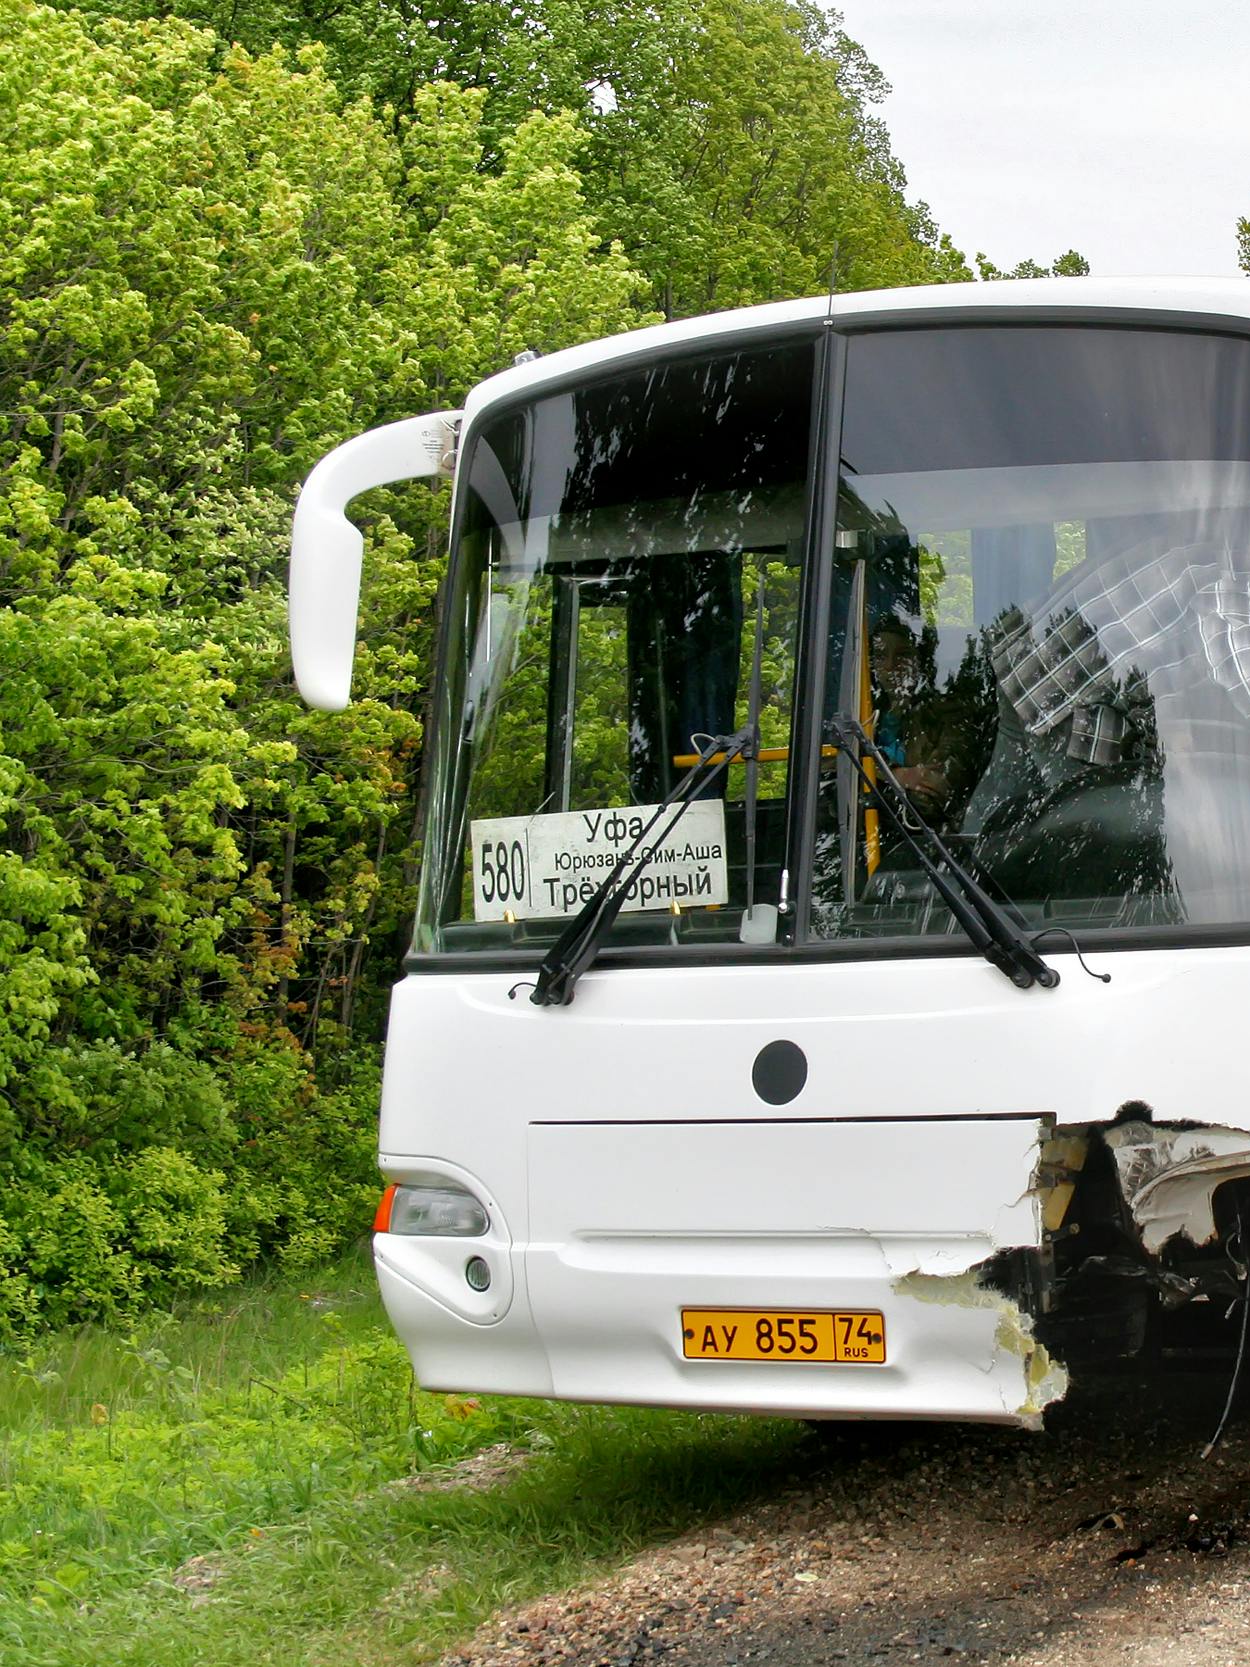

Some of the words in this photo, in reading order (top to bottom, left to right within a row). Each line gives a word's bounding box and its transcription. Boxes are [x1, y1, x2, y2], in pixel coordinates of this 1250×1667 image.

[583, 812, 644, 848] Уфа
[481, 840, 525, 903] 580
[543, 866, 712, 912] Трёгорный
[701, 1325, 738, 1353] АУ
[756, 1318, 818, 1354] 855
[838, 1317, 872, 1345] 74
[844, 1347, 869, 1358] RUS
